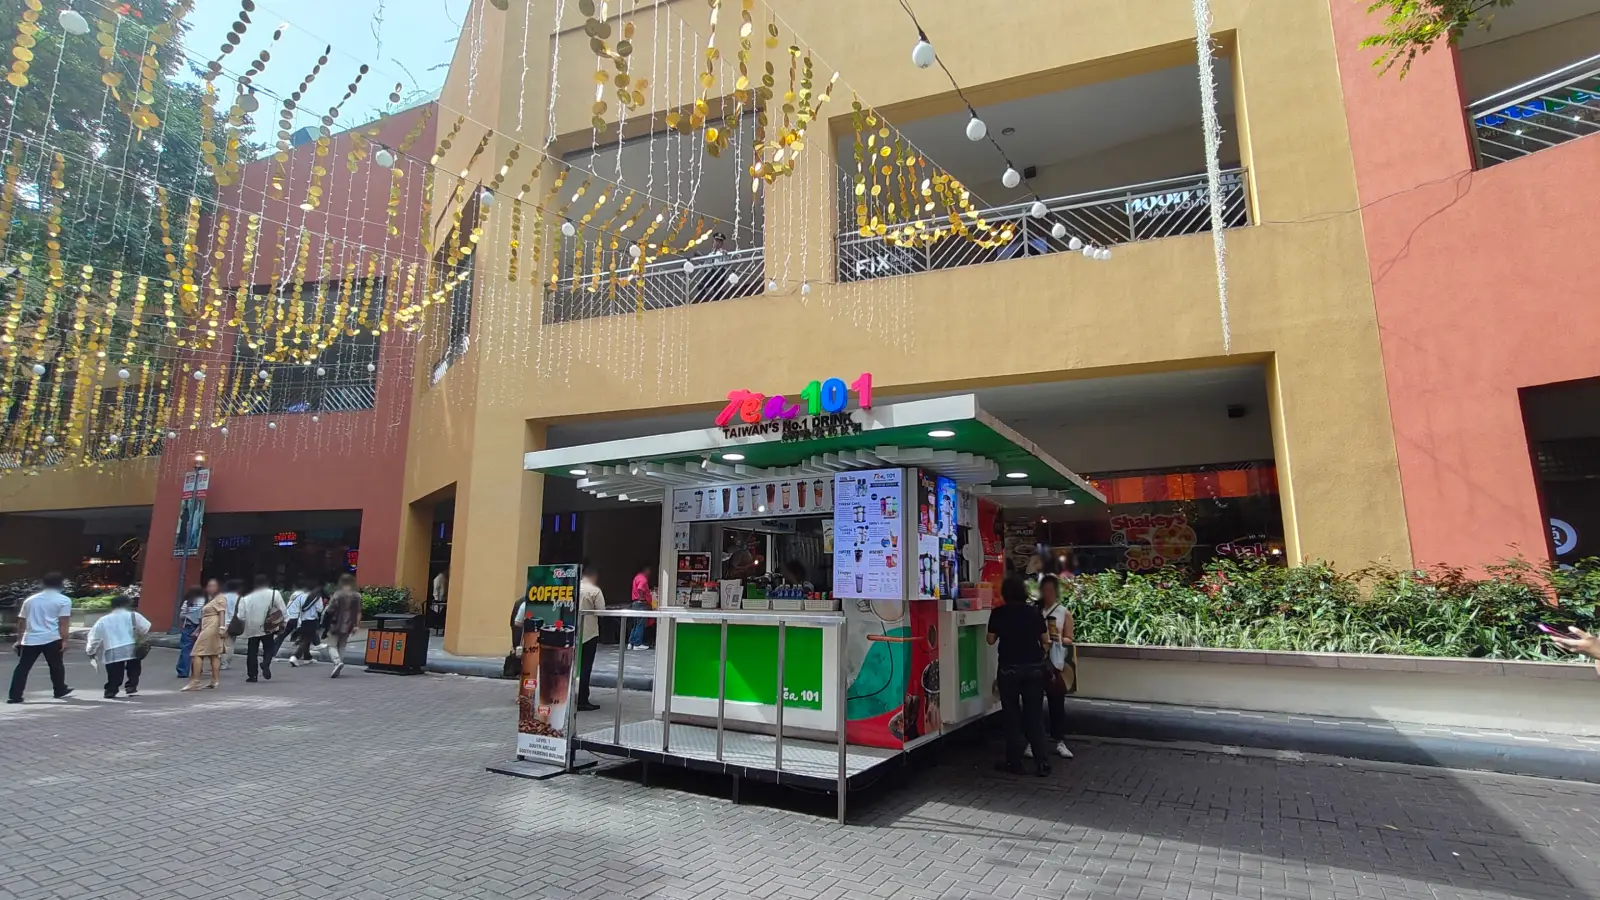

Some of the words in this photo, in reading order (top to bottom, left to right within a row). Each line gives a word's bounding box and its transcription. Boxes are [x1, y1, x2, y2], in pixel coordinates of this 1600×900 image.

[1175, 192, 1226, 212] LOUNE
[714, 388, 800, 426] Tea
[801, 372, 872, 415] 101
[722, 422, 779, 440] TAIWAN'S
[783, 418, 808, 433] No.1
[812, 412, 853, 428] DRINK
[1111, 514, 1187, 531] Shakey's
[528, 586, 573, 602] COFFEE
[801, 690, 819, 703] 101
